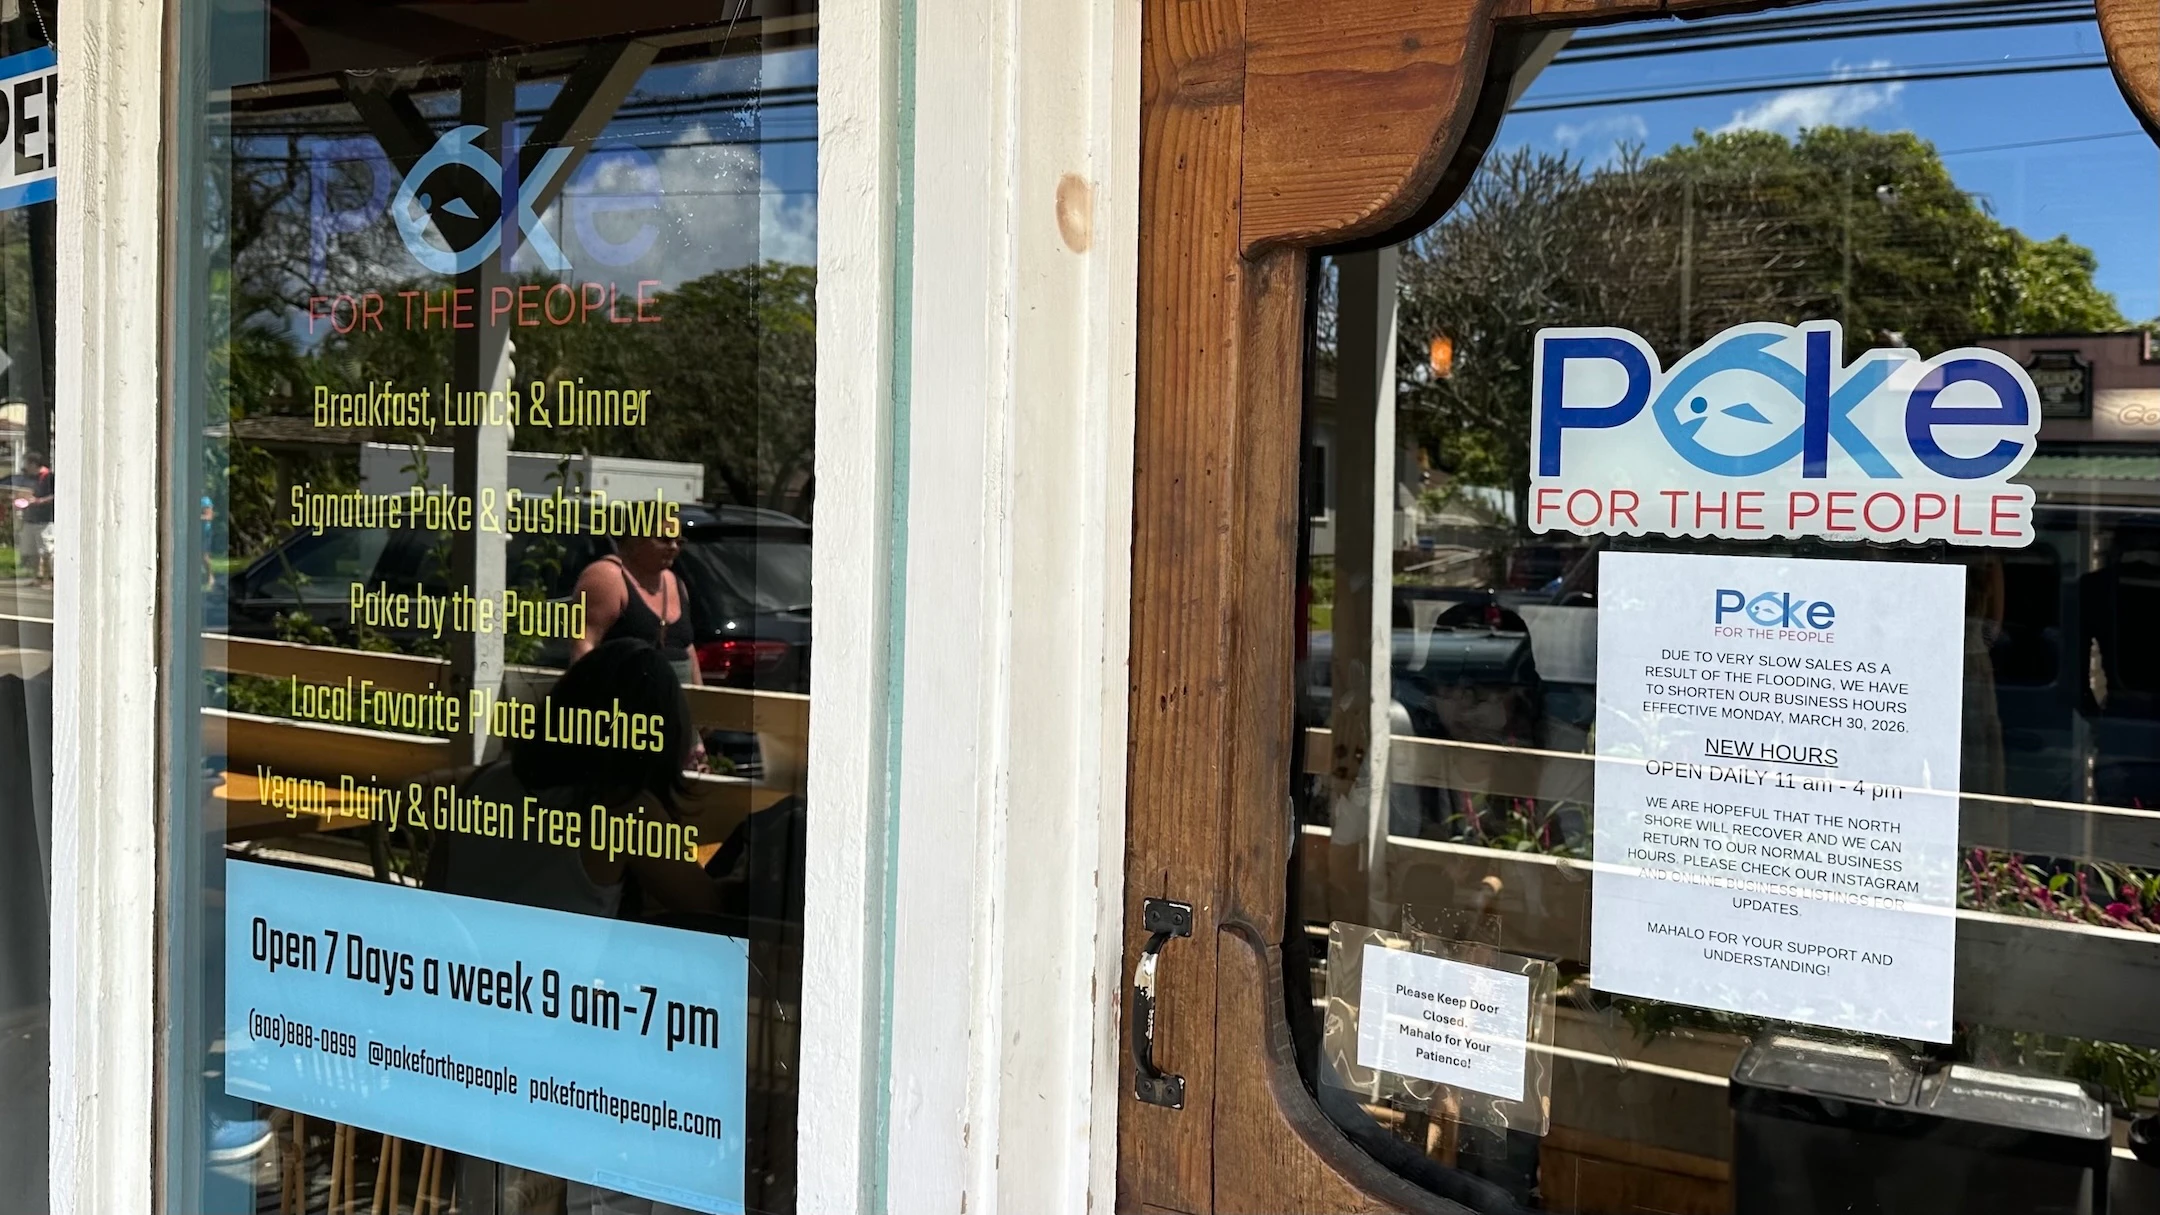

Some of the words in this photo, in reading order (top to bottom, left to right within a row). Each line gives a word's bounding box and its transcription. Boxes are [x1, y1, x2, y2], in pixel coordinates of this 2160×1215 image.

[309, 121, 663, 286] Poke
[308, 292, 385, 335] FOR
[398, 287, 477, 331] THE
[490, 278, 664, 329] PEOPLE
[315, 381, 437, 430] Breakfast,
[445, 381, 520, 425] Lunch
[530, 381, 551, 426] &
[559, 379, 649, 425] Dinner
[1538, 331, 2029, 479] Poke
[292, 484, 401, 535] Signature
[410, 486, 471, 530] Poke
[482, 490, 499, 531] &
[507, 488, 579, 533] Sushi
[590, 491, 679, 537] Bowls
[1538, 489, 1639, 525] FOR
[1660, 491, 1764, 529] THE
[1789, 492, 2023, 536] PEOPLE
[351, 583, 408, 627] Poke
[417, 585, 447, 638] by
[452, 588, 493, 633] the
[502, 590, 586, 639] Pound
[1716, 589, 1835, 630] Poke
[1714, 626, 1744, 639] FOR
[1748, 628, 1775, 641] THE
[1778, 629, 1835, 644] PEOPLE
[1646, 666, 1697, 679] RESULT
[1702, 670, 1720, 680] OF
[1725, 672, 1752, 683] THE
[1757, 674, 1835, 689] FLOODING,
[1841, 680, 1864, 691] WE
[1870, 682, 1908, 694] HAVE
[1662, 649, 1689, 661] DUE
[1695, 652, 1712, 662] TO
[1717, 653, 1754, 665] VERY
[1759, 656, 1801, 668] SLOW
[1806, 659, 1852, 671] SALES
[1857, 662, 1876, 673] AS
[1881, 664, 1891, 674] A
[292, 674, 352, 721] Local
[361, 680, 459, 732] Favorite
[469, 690, 535, 739] Plate
[545, 699, 663, 752] Lunches
[1644, 701, 1717, 717] EFFECTIVE
[1722, 708, 1785, 722] MONDAY,
[1790, 713, 1841, 727] MARCH
[1847, 718, 1866, 730] 30,
[1872, 720, 1908, 732] 2026.
[1646, 684, 1664, 694] TO
[1668, 686, 1734, 700] SHORTEN
[1739, 691, 1769, 703] OUR
[1775, 694, 1847, 708] BUSINESS
[1853, 699, 1906, 713] HOURS
[1704, 738, 1755, 759] NEW
[1759, 741, 1839, 765] HOURS
[1646, 762, 1701, 779] OPEN
[1710, 766, 1767, 785] DAILY
[1776, 773, 1795, 788] 11
[1802, 775, 1834, 794] am
[1853, 780, 1865, 795] 4
[1873, 784, 1901, 801] pm
[256, 765, 333, 823] Vegan,
[340, 774, 402, 832] Dairy
[408, 784, 427, 828] &
[434, 786, 512, 837] Gluten
[524, 797, 581, 847] Free
[591, 805, 698, 862] Options
[1645, 814, 1692, 829] SHORE
[1696, 820, 1728, 833] WILL
[1733, 824, 1802, 841] RECOVER
[1807, 833, 1837, 845] AND
[1842, 836, 1865, 849] WE
[1871, 840, 1901, 852] CAN
[1646, 797, 1667, 808] WE
[1671, 800, 1698, 812] ARE
[1704, 803, 1769, 819] HOPEFUL
[1774, 810, 1810, 823] THAT
[1815, 814, 1843, 827] THE
[1849, 818, 1900, 833] NORTH
[1628, 848, 1679, 863] HOURS.
[1684, 855, 1736, 871] PLEASE
[1742, 862, 1790, 877] CHECK
[1796, 869, 1826, 882] OUR
[1833, 873, 1918, 894] INSTAGRAM
[1644, 832, 1698, 848] RETURN
[1704, 839, 1721, 850] TO
[1727, 842, 1756, 855] OUR
[1762, 846, 1822, 863] NORMAL
[1828, 853, 1902, 872] BUSINESS
[1638, 866, 1669, 881] AND
[1671, 870, 1723, 888] ONLINE
[1726, 876, 1799, 897] BUSINESS
[1801, 886, 1869, 907] LISTINGS
[1872, 896, 1905, 911] FOR
[1733, 898, 1802, 915] UPDATES.
[1648, 922, 1704, 939] MAHALO
[1709, 931, 1737, 944] FOR
[1742, 935, 1782, 951] YOUR
[1788, 942, 1857, 960] SUPPORT
[1862, 952, 1892, 965] AND
[1703, 948, 1832, 976] UNDERSTANDING!
[253, 917, 316, 972] Open
[325, 930, 338, 974] 7
[347, 934, 413, 995] Days
[424, 959, 438, 995] a
[448, 961, 533, 1014] week
[543, 969, 559, 1018] 9
[572, 985, 657, 1035] am-7
[668, 1001, 718, 1051] pm
[1397, 984, 1434, 1001] Please
[1438, 993, 1466, 1009] Keep
[1471, 1000, 1499, 1014] Door
[1400, 1024, 1441, 1042] Mahalo
[1445, 1035, 1461, 1046] for
[1465, 1038, 1491, 1052] Your
[1423, 1010, 1467, 1026] Closed.
[250, 1008, 356, 1058] (808)888-0899
[369, 1041, 517, 1095] @pokeforthepeople
[530, 1077, 720, 1139] pokeforthepeople.com
[1417, 1048, 1470, 1068] Patience!
